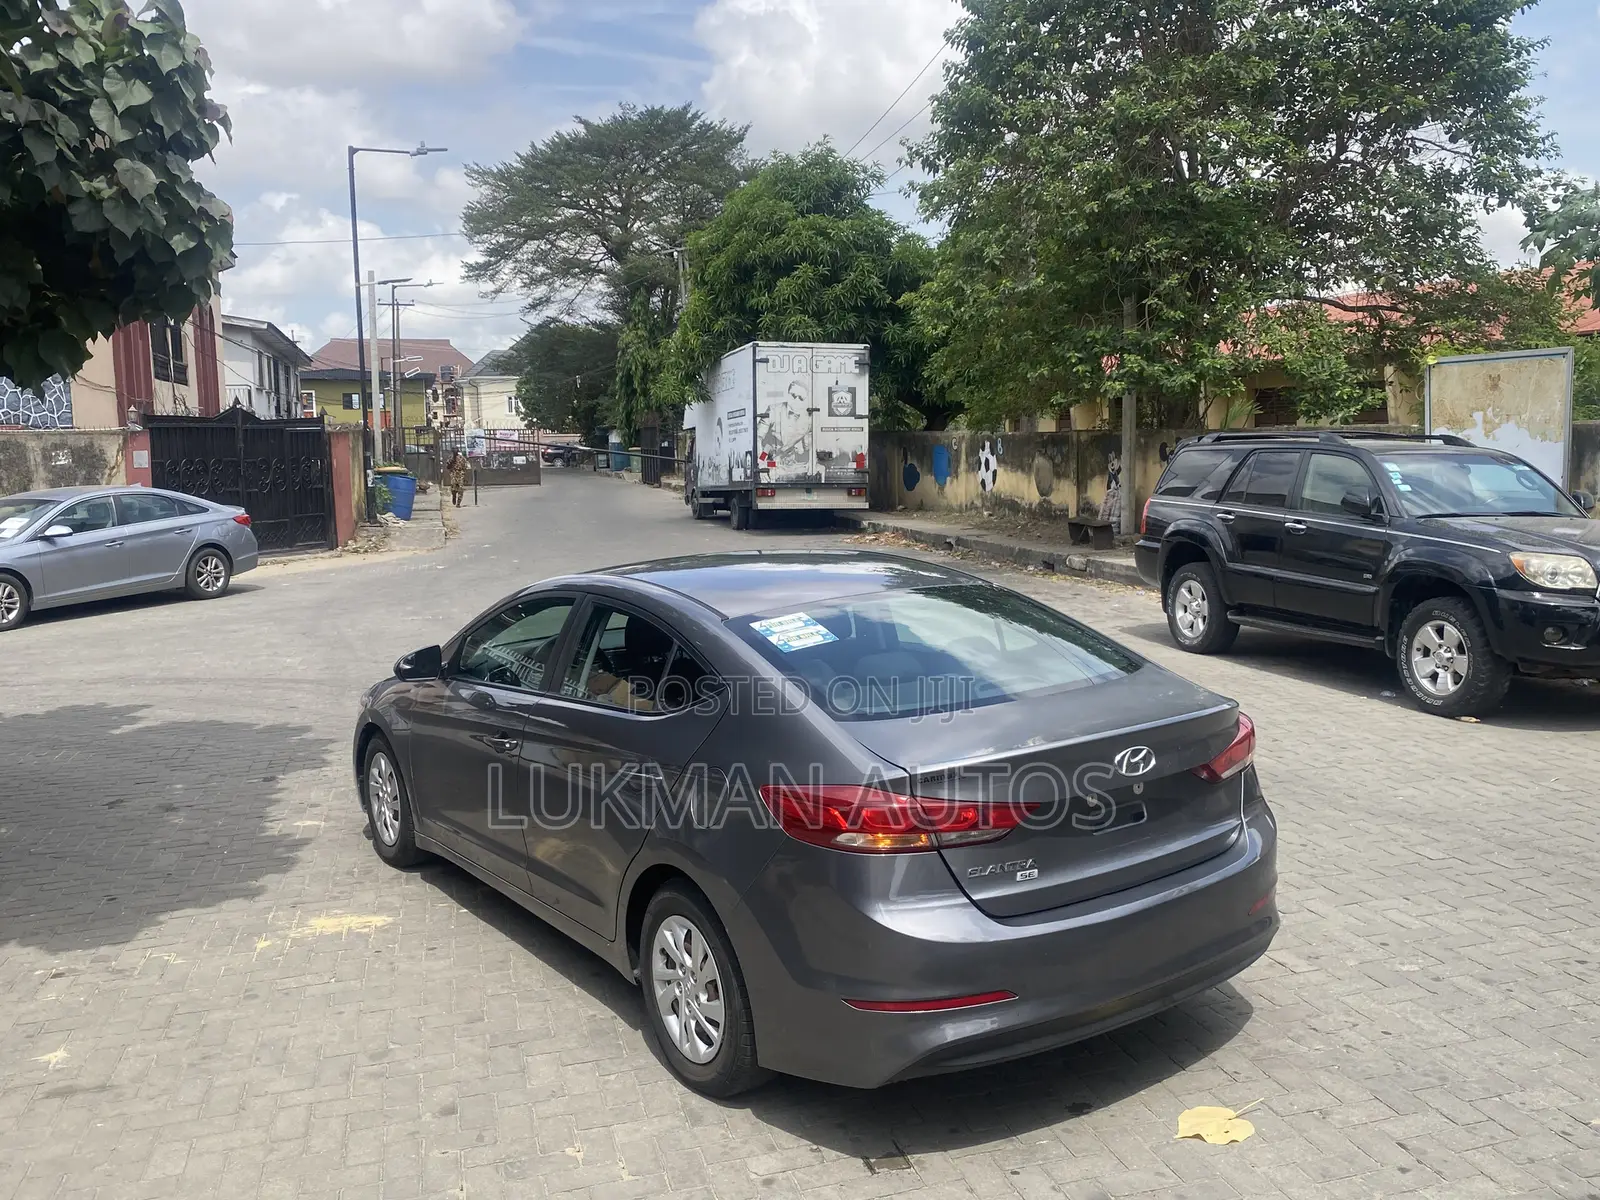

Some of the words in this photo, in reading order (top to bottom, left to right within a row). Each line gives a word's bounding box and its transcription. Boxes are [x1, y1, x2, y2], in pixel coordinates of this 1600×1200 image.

[792, 354, 808, 374] A
[810, 354, 860, 374] GAME
[968, 858, 1037, 879] ELANTRA
[1020, 869, 1036, 880] SE
